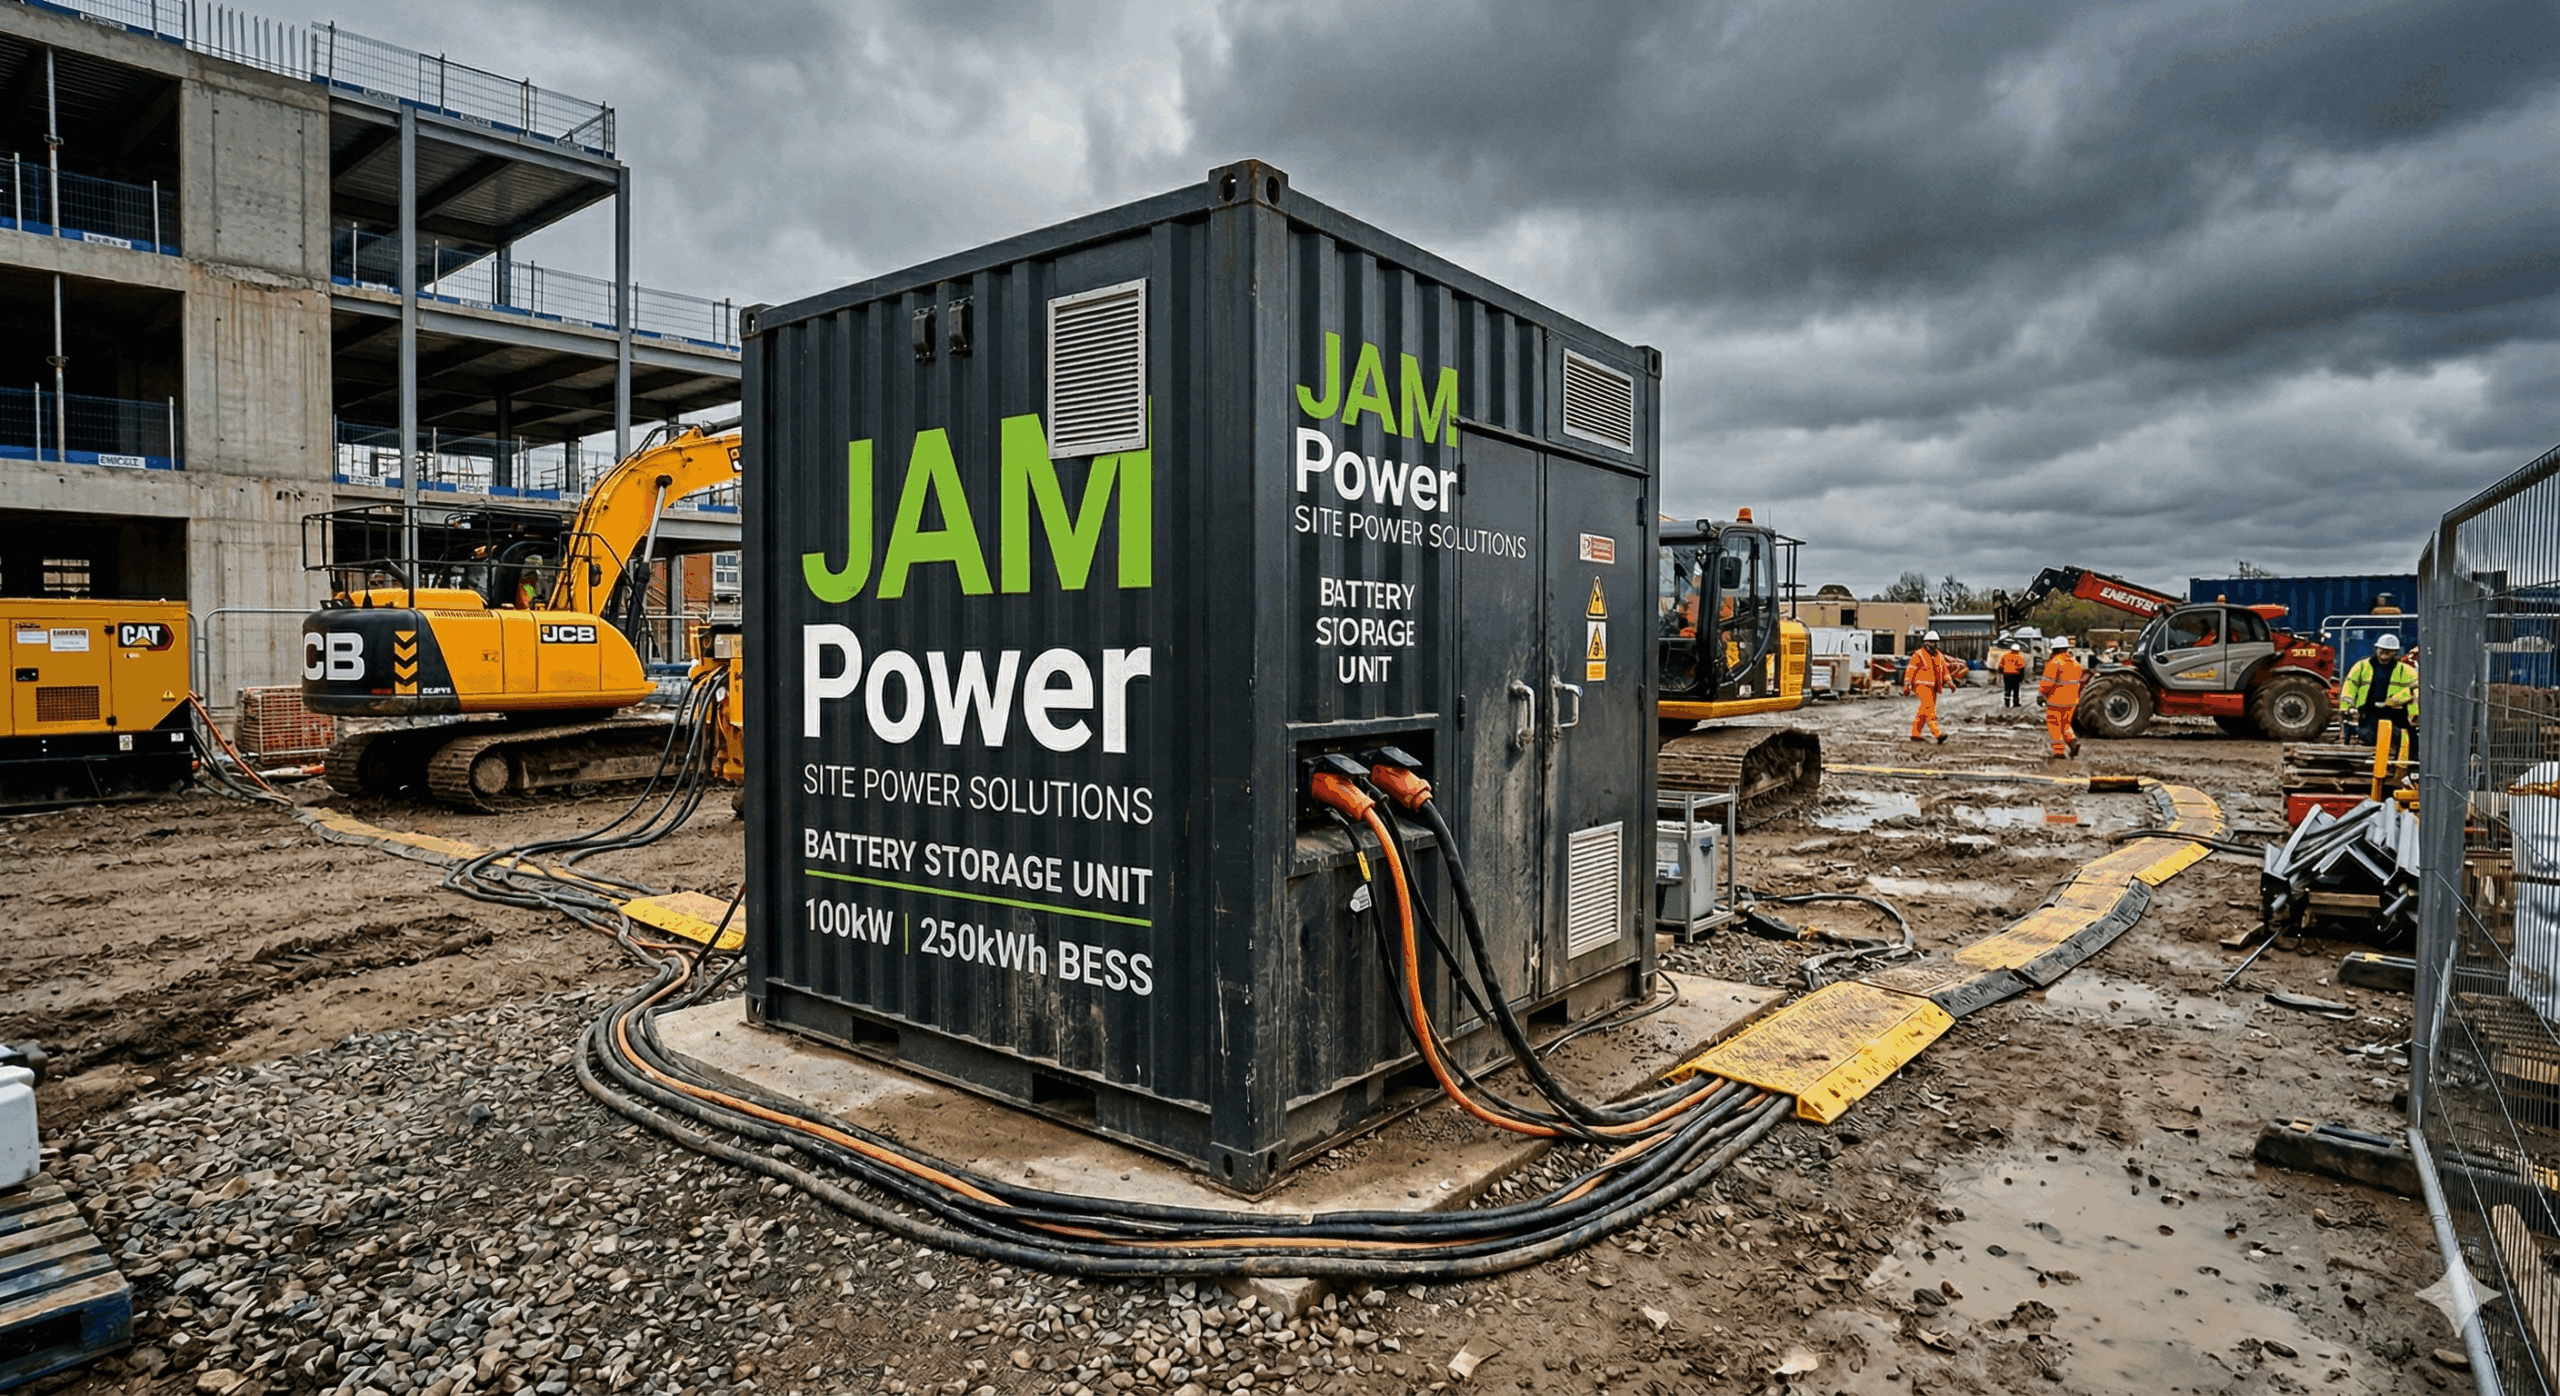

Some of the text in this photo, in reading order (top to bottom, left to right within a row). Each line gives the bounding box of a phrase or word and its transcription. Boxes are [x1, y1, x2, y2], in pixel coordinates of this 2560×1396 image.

[1295, 330, 1459, 449] JAM
[802, 396, 1153, 604] JAM
[1296, 426, 1458, 514] Power
[1294, 504, 1527, 559] SITE POWER SOLUTIONS
[1320, 576, 1416, 612] BATTERY
[121, 624, 161, 646] CAT
[542, 625, 596, 642] JCB
[1315, 616, 1415, 648] STORAGE
[803, 623, 1152, 754] Power
[1338, 655, 1393, 684] UNIT
[803, 763, 1153, 825] SITE POWER SOLUTIONS
[804, 828, 1153, 905] BATTERY STORAGE UNIT
[805, 897, 1153, 996] 100kW 250kWh BESS
